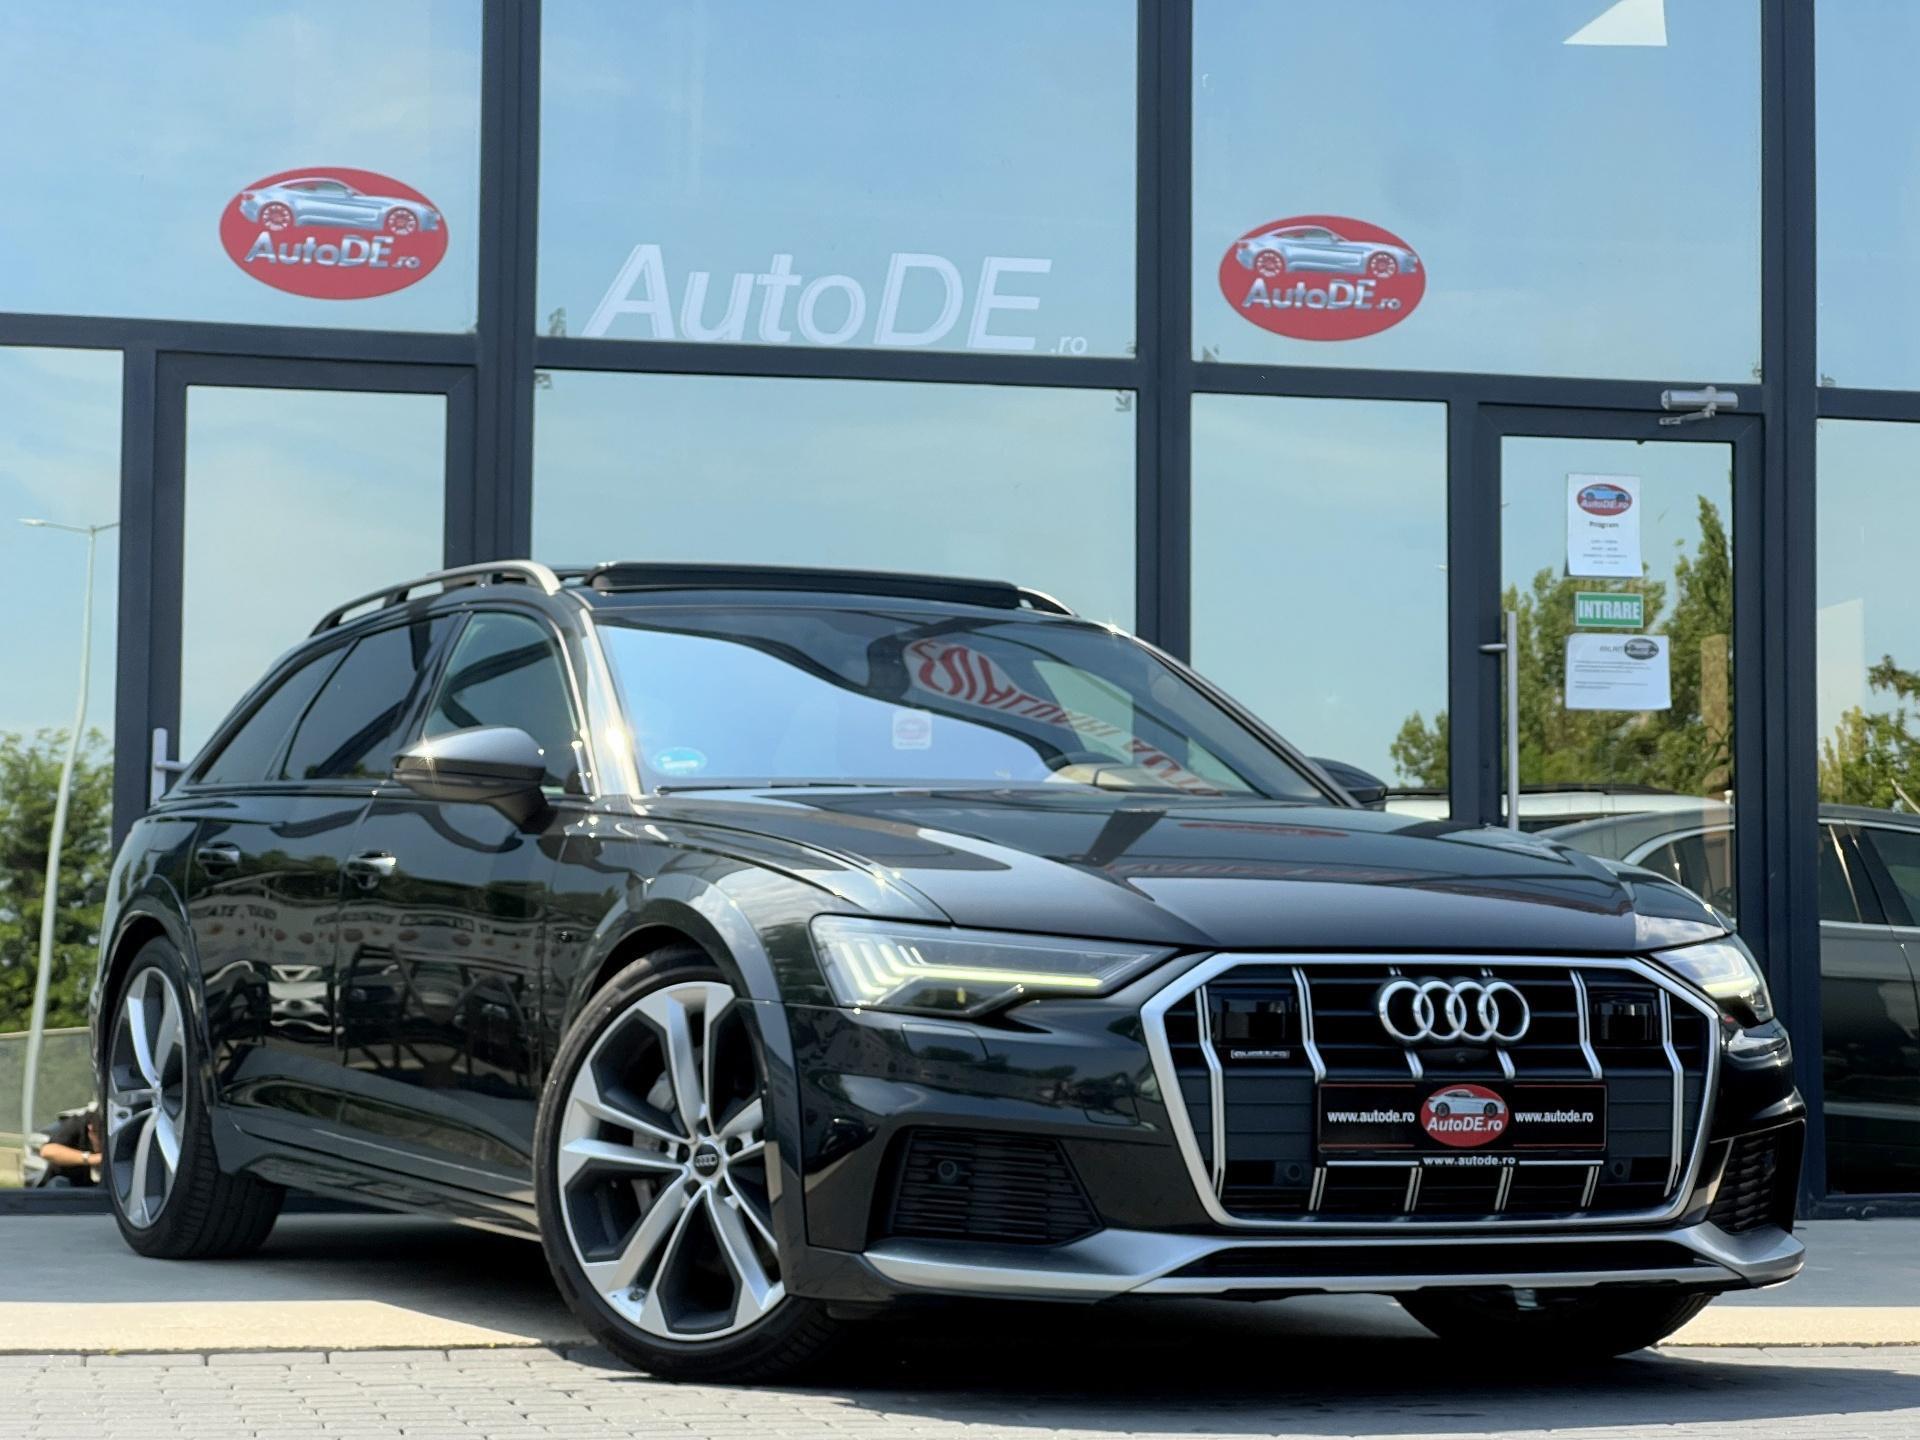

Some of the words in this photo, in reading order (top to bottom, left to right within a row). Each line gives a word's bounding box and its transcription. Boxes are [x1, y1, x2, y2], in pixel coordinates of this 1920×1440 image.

[1579, 600, 1640, 619] INTRARE
[1327, 1110, 1415, 1123] www.autode.ro
[1515, 1111, 1594, 1123] www.autode.ro
[1427, 1117, 1503, 1132] AutoDE.ro
[1423, 1155, 1516, 1166] www.autode.ro
